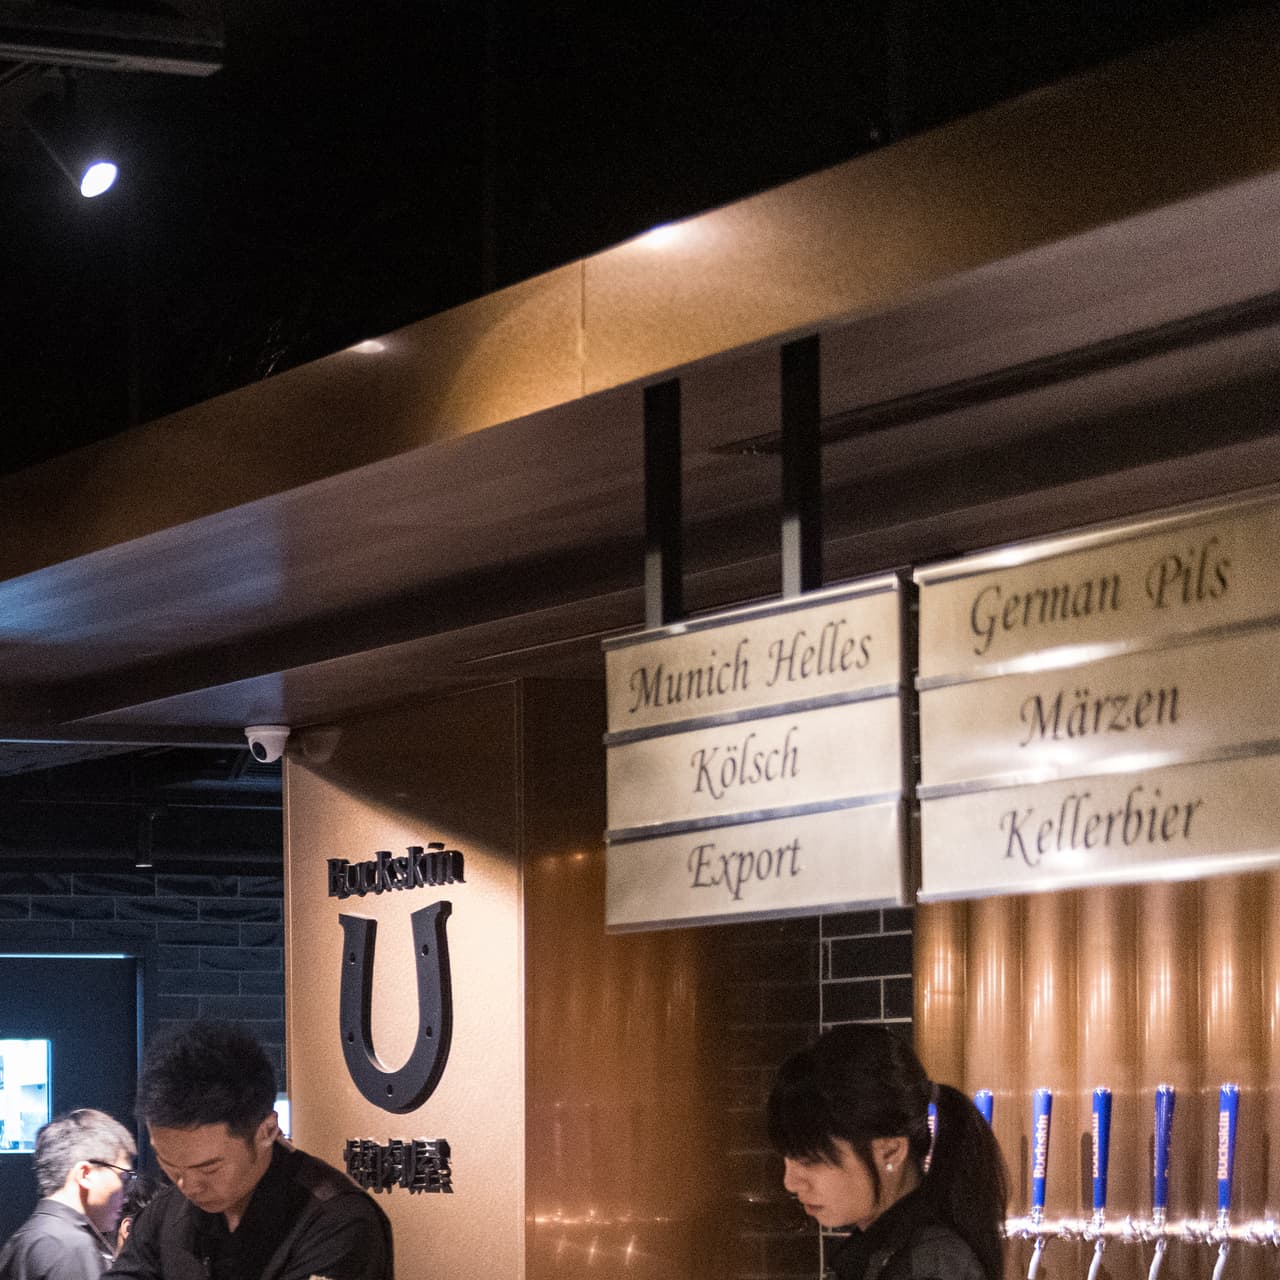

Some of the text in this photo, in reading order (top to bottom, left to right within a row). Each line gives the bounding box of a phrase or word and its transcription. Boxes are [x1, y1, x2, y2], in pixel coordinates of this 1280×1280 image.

[971, 535, 1233, 656] German Pils
[628, 619, 873, 713] Munich Helles
[1019, 685, 1181, 747] Märzen
[690, 726, 800, 799] Kölsch
[999, 785, 1203, 866] Kellerbier
[687, 837, 801, 900] Export
